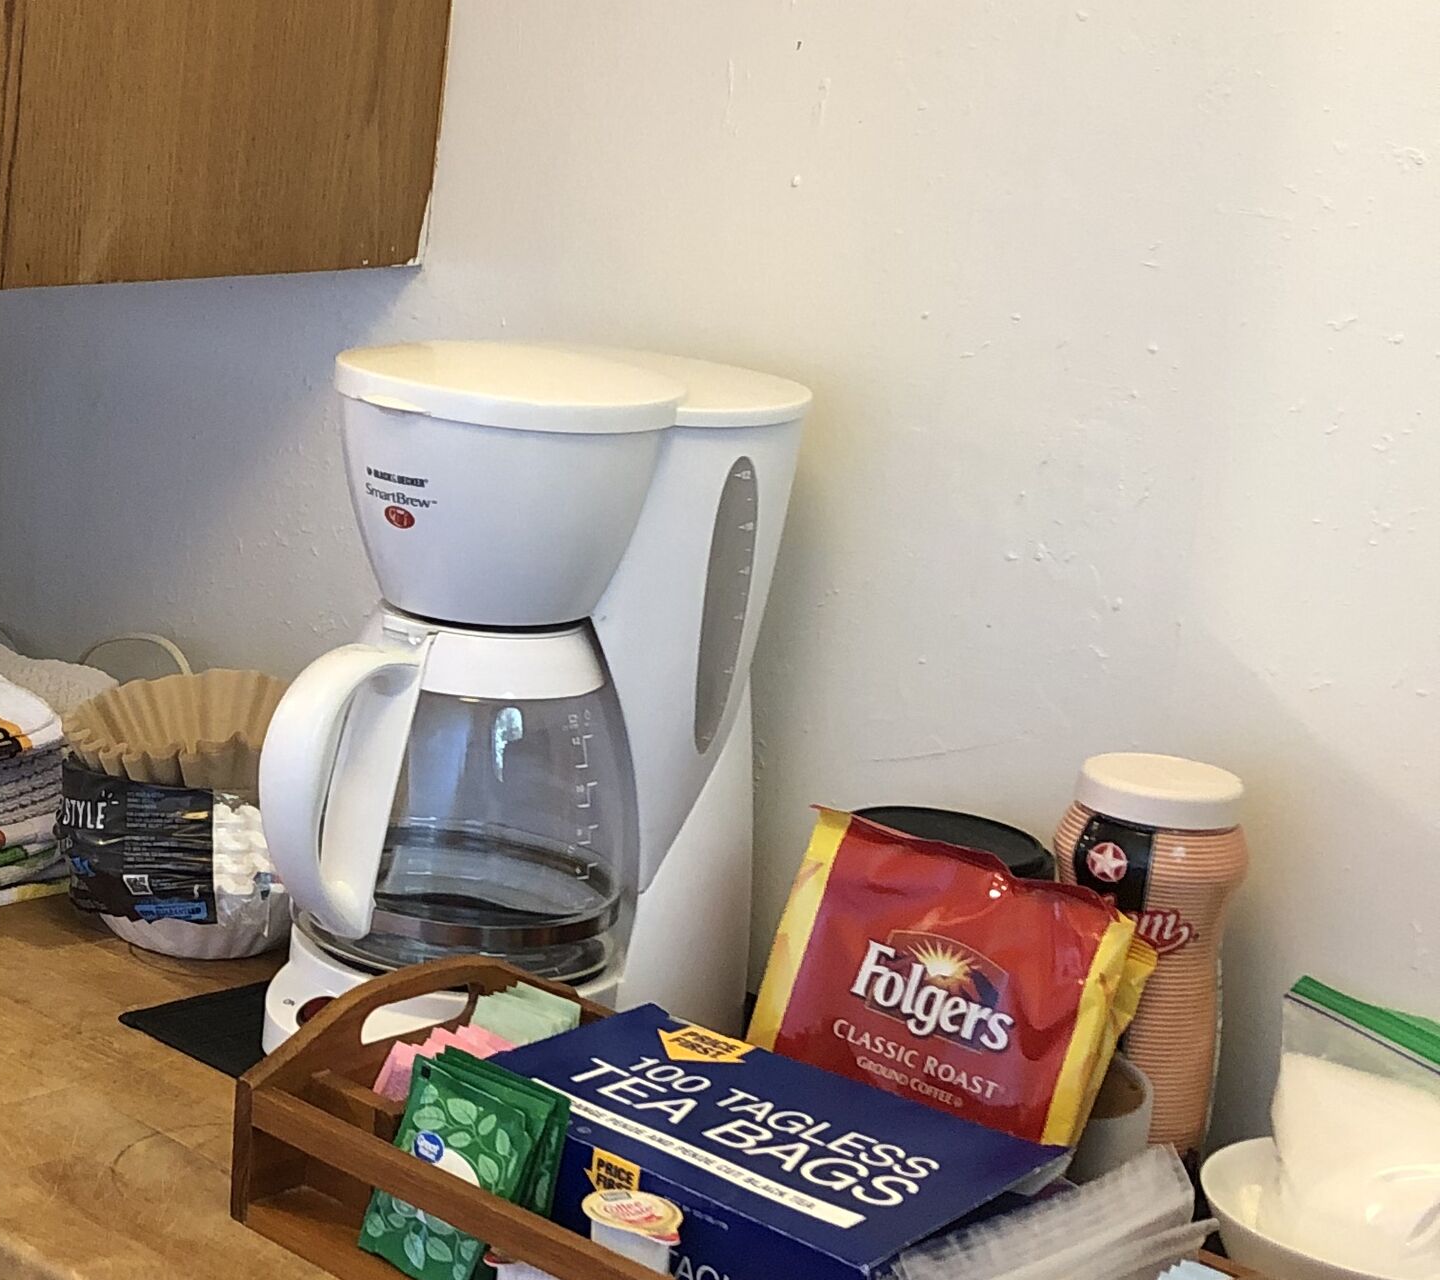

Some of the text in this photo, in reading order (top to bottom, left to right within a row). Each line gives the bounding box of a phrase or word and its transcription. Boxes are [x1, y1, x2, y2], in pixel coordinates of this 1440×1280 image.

[63, 797, 108, 830] STYLE
[850, 939, 1015, 1051] Folgers
[668, 1037, 728, 1059] FIRST
[681, 1031, 741, 1054] PRICE
[832, 1019, 1000, 1099] CLASSIC ROAST
[856, 1056, 910, 1086] GROUND
[570, 1057, 920, 1207] TEA BAGS
[628, 1056, 941, 1180] 100 TAGLESS
[596, 1157, 635, 1188] PRICE
[743, 1176, 789, 1198] BLACK
